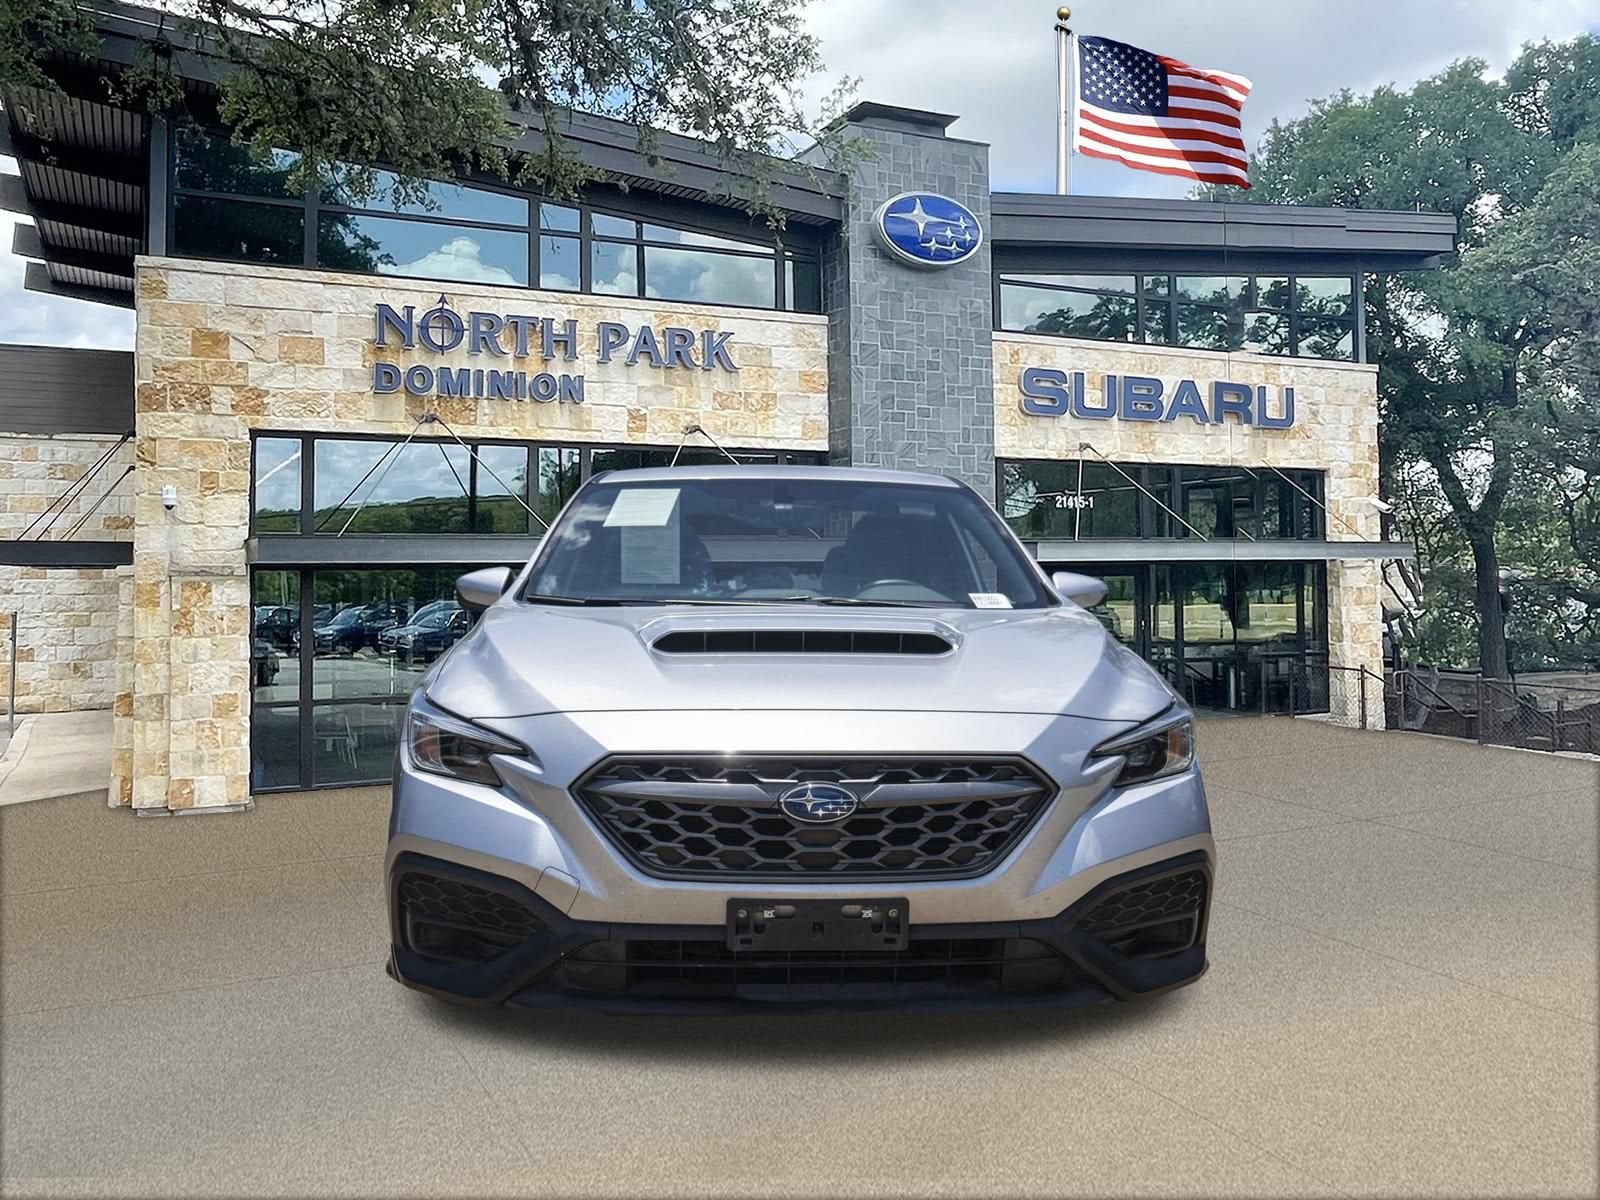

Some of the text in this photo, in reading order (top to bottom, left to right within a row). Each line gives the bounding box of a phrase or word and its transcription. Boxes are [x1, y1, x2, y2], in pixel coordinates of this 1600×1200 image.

[375, 295, 740, 373] NORTH PARK
[374, 363, 585, 403] DOMINION
[1019, 367, 1296, 430] SUBARU
